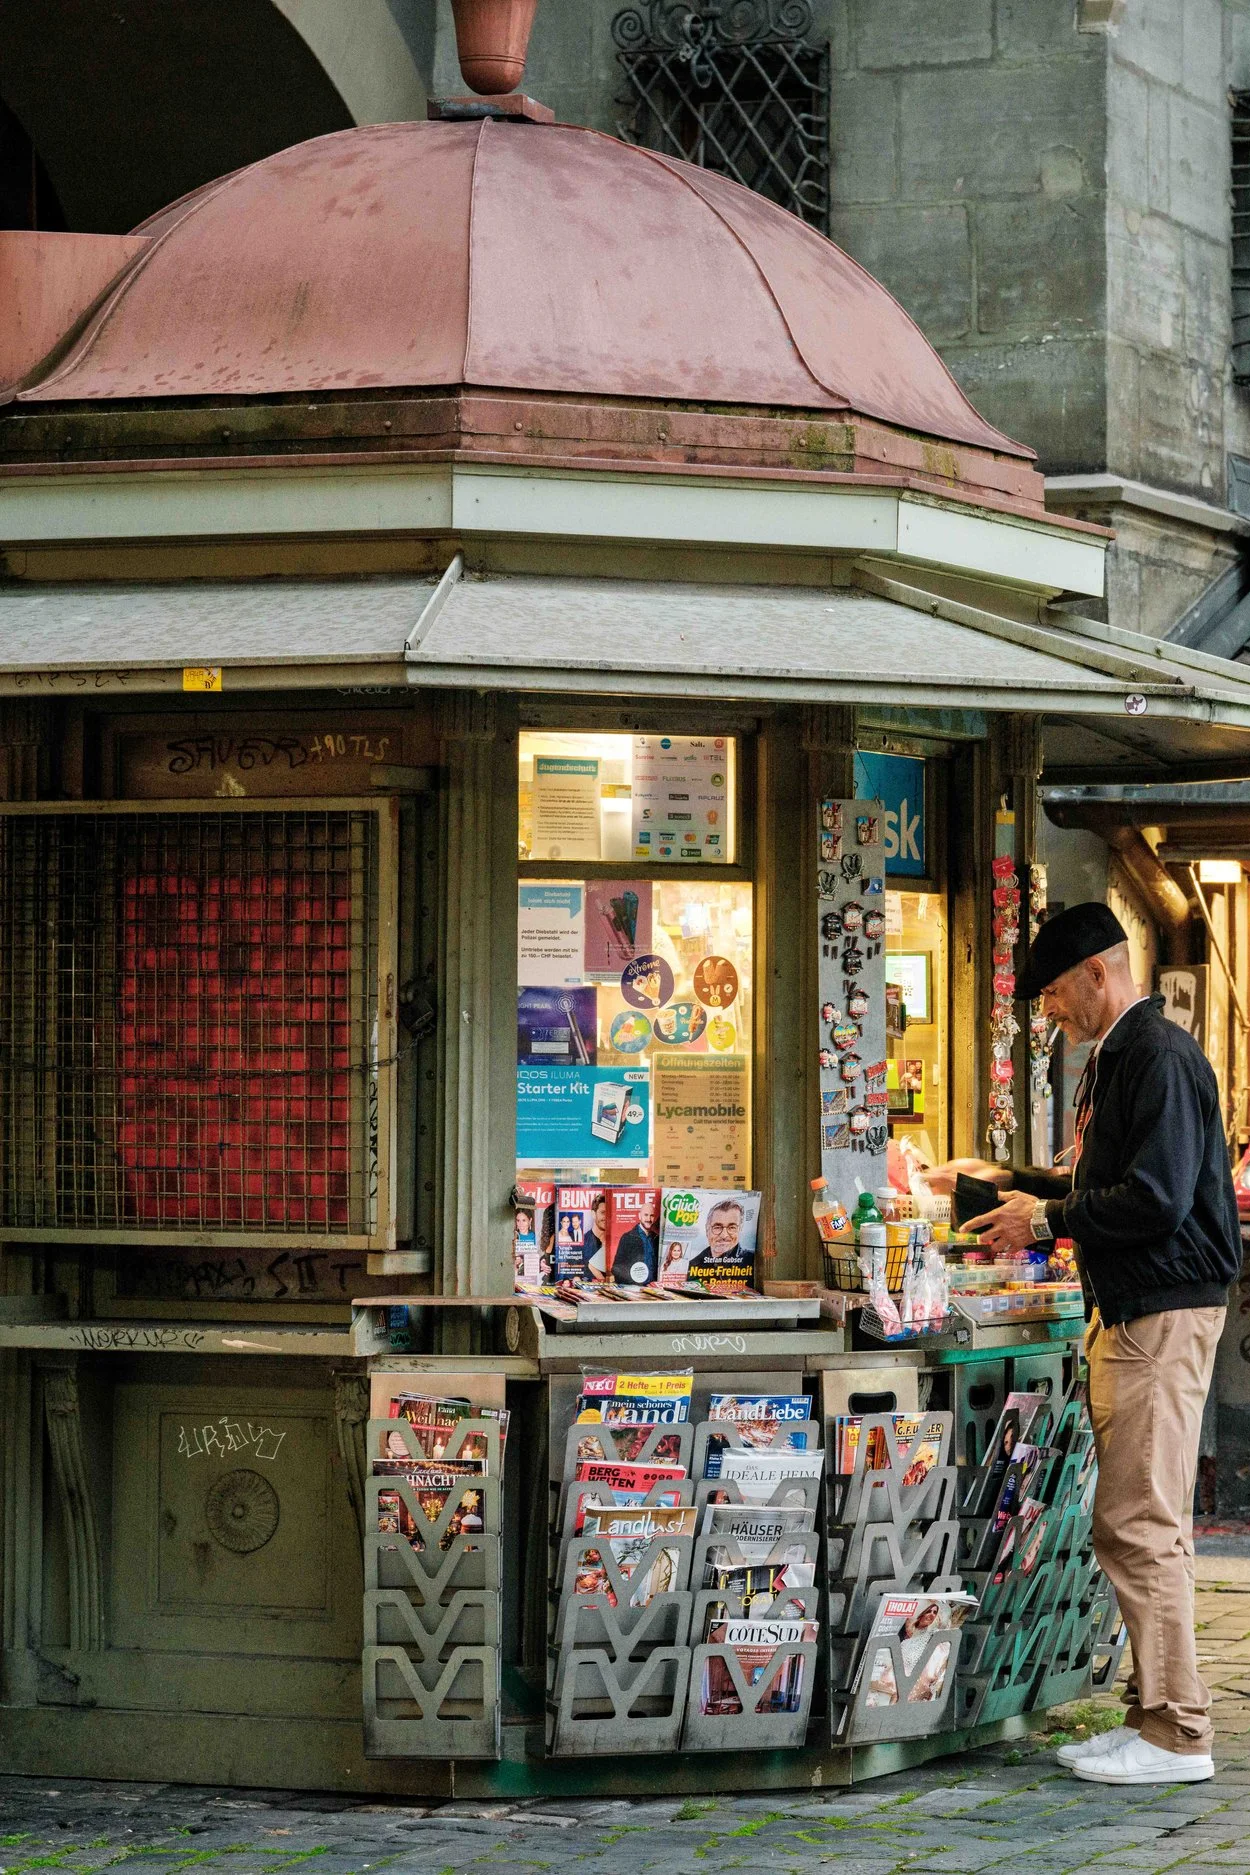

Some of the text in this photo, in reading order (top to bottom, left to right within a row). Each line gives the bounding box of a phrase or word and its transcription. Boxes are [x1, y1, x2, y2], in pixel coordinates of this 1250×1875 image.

[539, 764, 597, 773] Jugendschutz
[550, 1071, 581, 1079] ILUMA
[517, 1082, 590, 1094] Starter Kit
[656, 1103, 746, 1119] Lycamobile
[612, 1192, 656, 1209] TELE
[675, 1209, 700, 1224] Post
[703, 1256, 744, 1264] Stefan Gubser
[689, 1265, 753, 1277] Neue Freiheit
[583, 1379, 615, 1391] NEU
[619, 1380, 625, 1389] 2
[627, 1381, 649, 1389] Hefte
[611, 1400, 635, 1409] mein
[599, 1400, 682, 1424] Land
[715, 1403, 805, 1421] LandLiebe
[588, 1466, 621, 1477] BERG
[726, 1470, 816, 1481] IDEALE HEIM
[596, 1510, 686, 1540] Landlust
[730, 1521, 783, 1536] HÄUSER
[887, 1601, 915, 1613] ¡HOLA!
